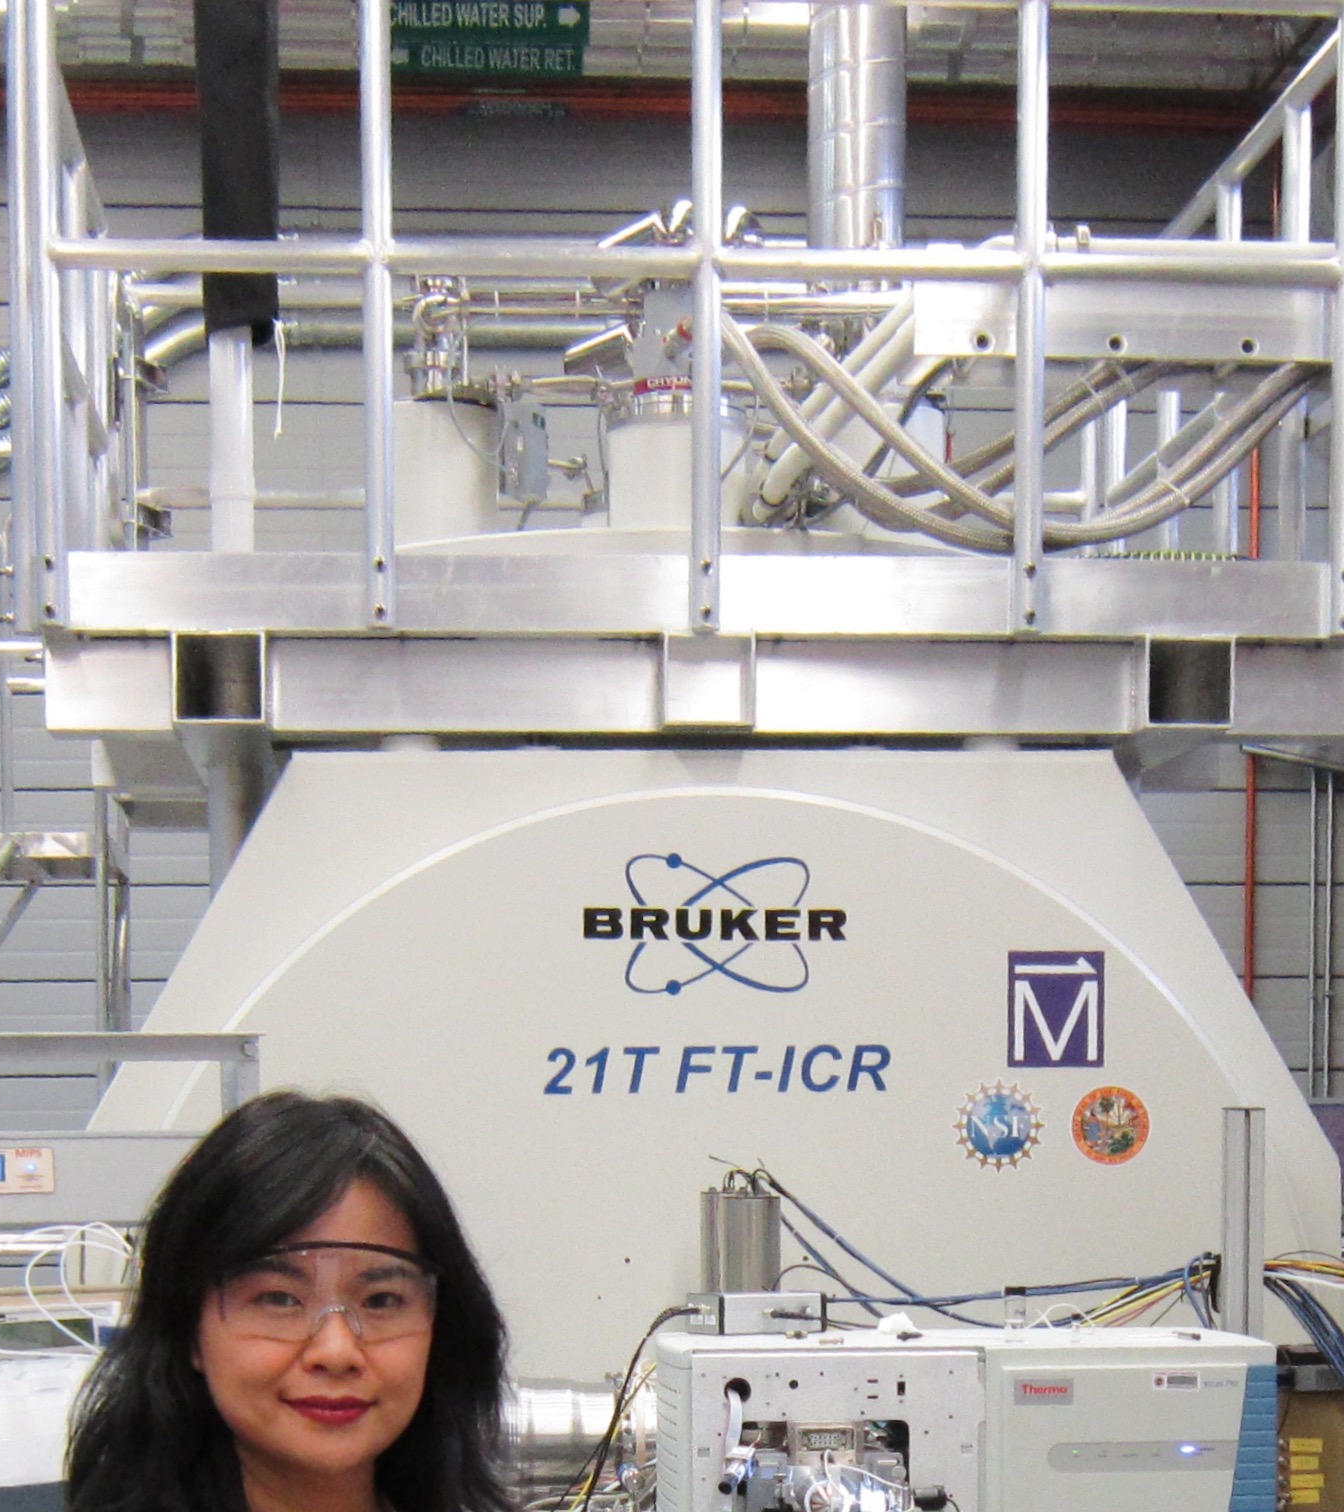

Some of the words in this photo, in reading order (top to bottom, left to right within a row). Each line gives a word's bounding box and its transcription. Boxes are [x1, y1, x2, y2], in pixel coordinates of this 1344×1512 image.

[391, 2, 453, 27] CHILLED
[457, 3, 510, 28] WATER
[514, 4, 548, 28] SUP.
[420, 47, 485, 68] CHILLED
[488, 48, 542, 70] WATER
[582, 907, 848, 941] BRUKER
[543, 1045, 661, 1095] 21T
[674, 1043, 893, 1094] FT-ICR
[971, 1115, 1029, 1138] NSF
[1021, 1383, 1068, 1395] Thermo
